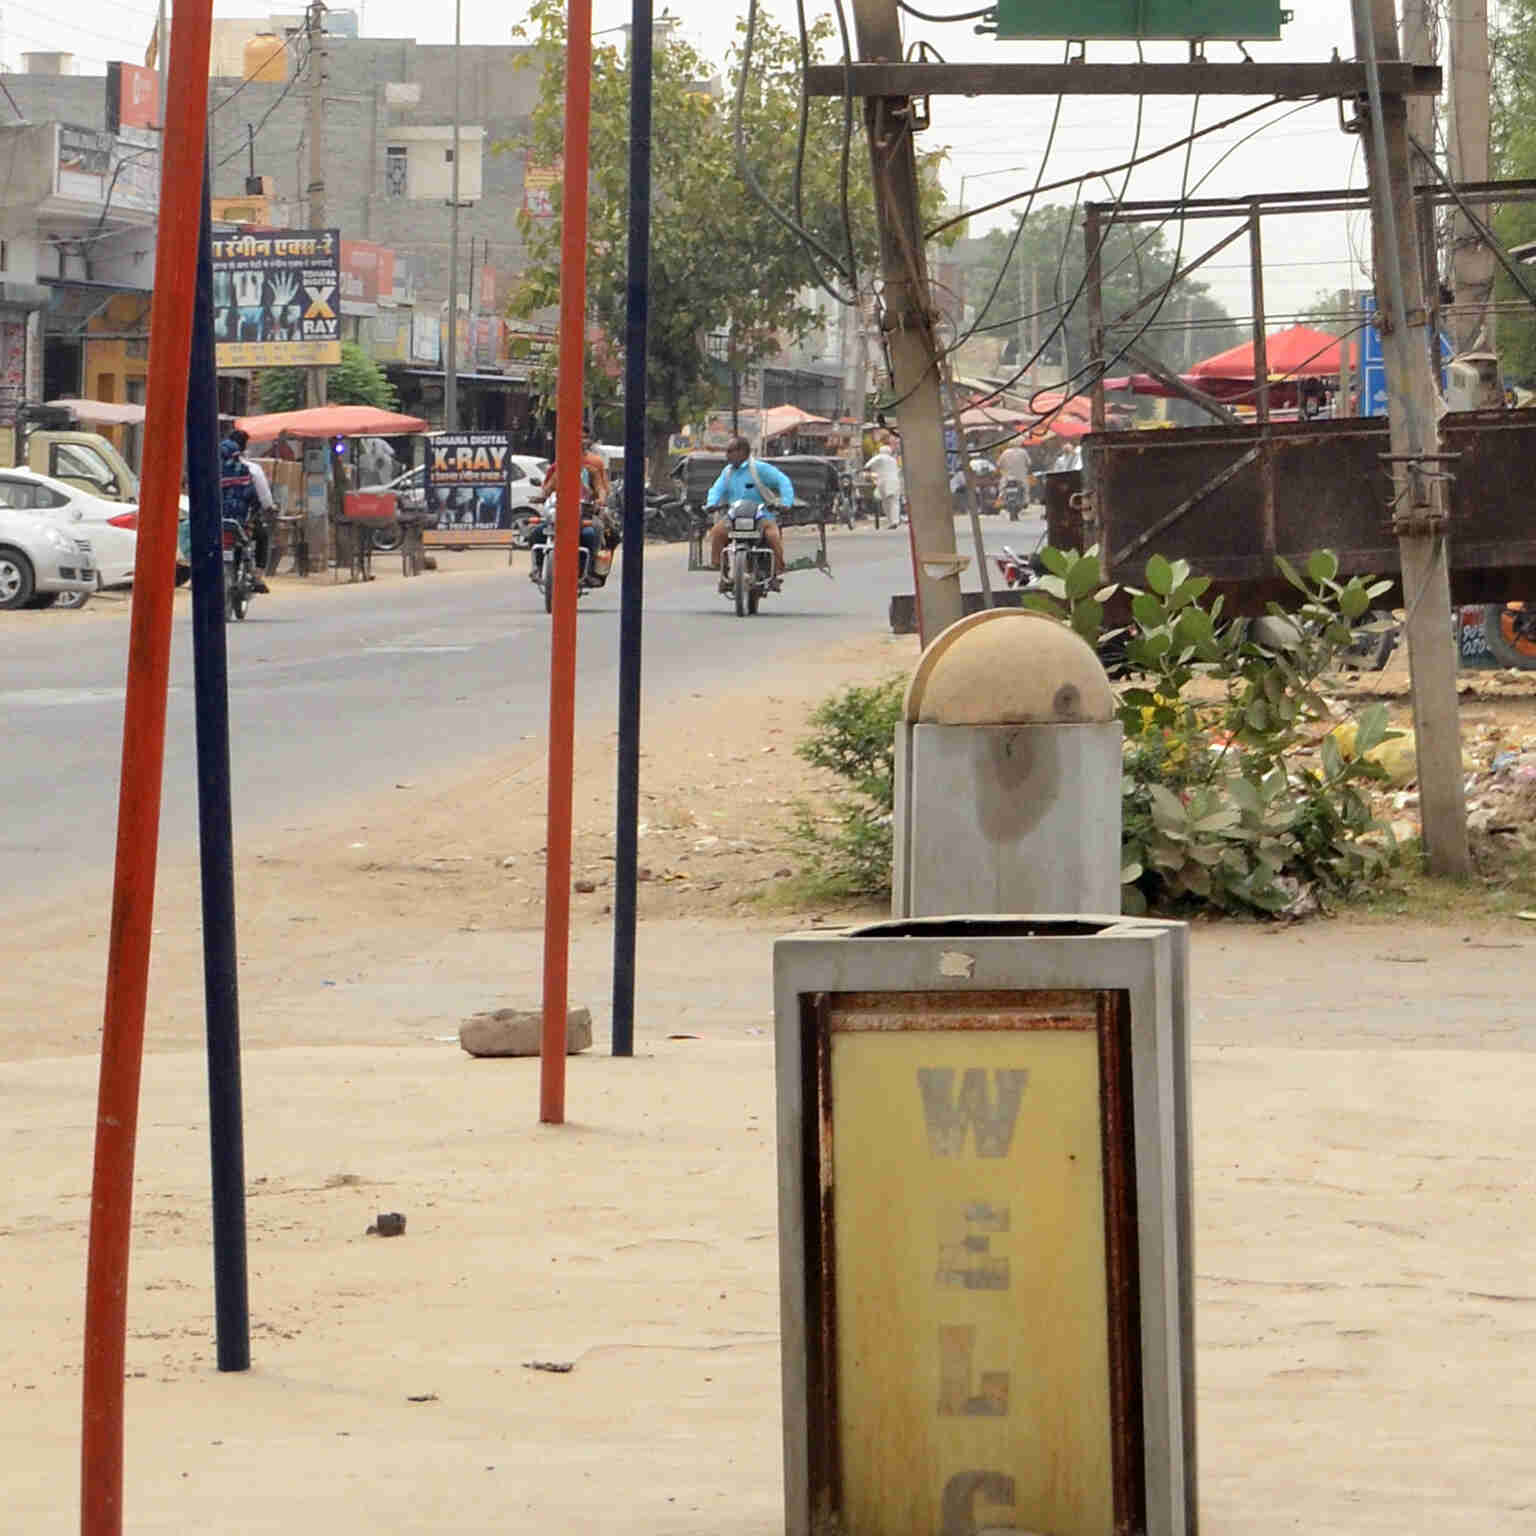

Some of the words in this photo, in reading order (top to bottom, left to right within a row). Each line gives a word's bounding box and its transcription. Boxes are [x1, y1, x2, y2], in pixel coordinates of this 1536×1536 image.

[303, 286, 337, 319] X
[303, 319, 337, 333] RAY
[432, 447, 508, 471] X-RAY
